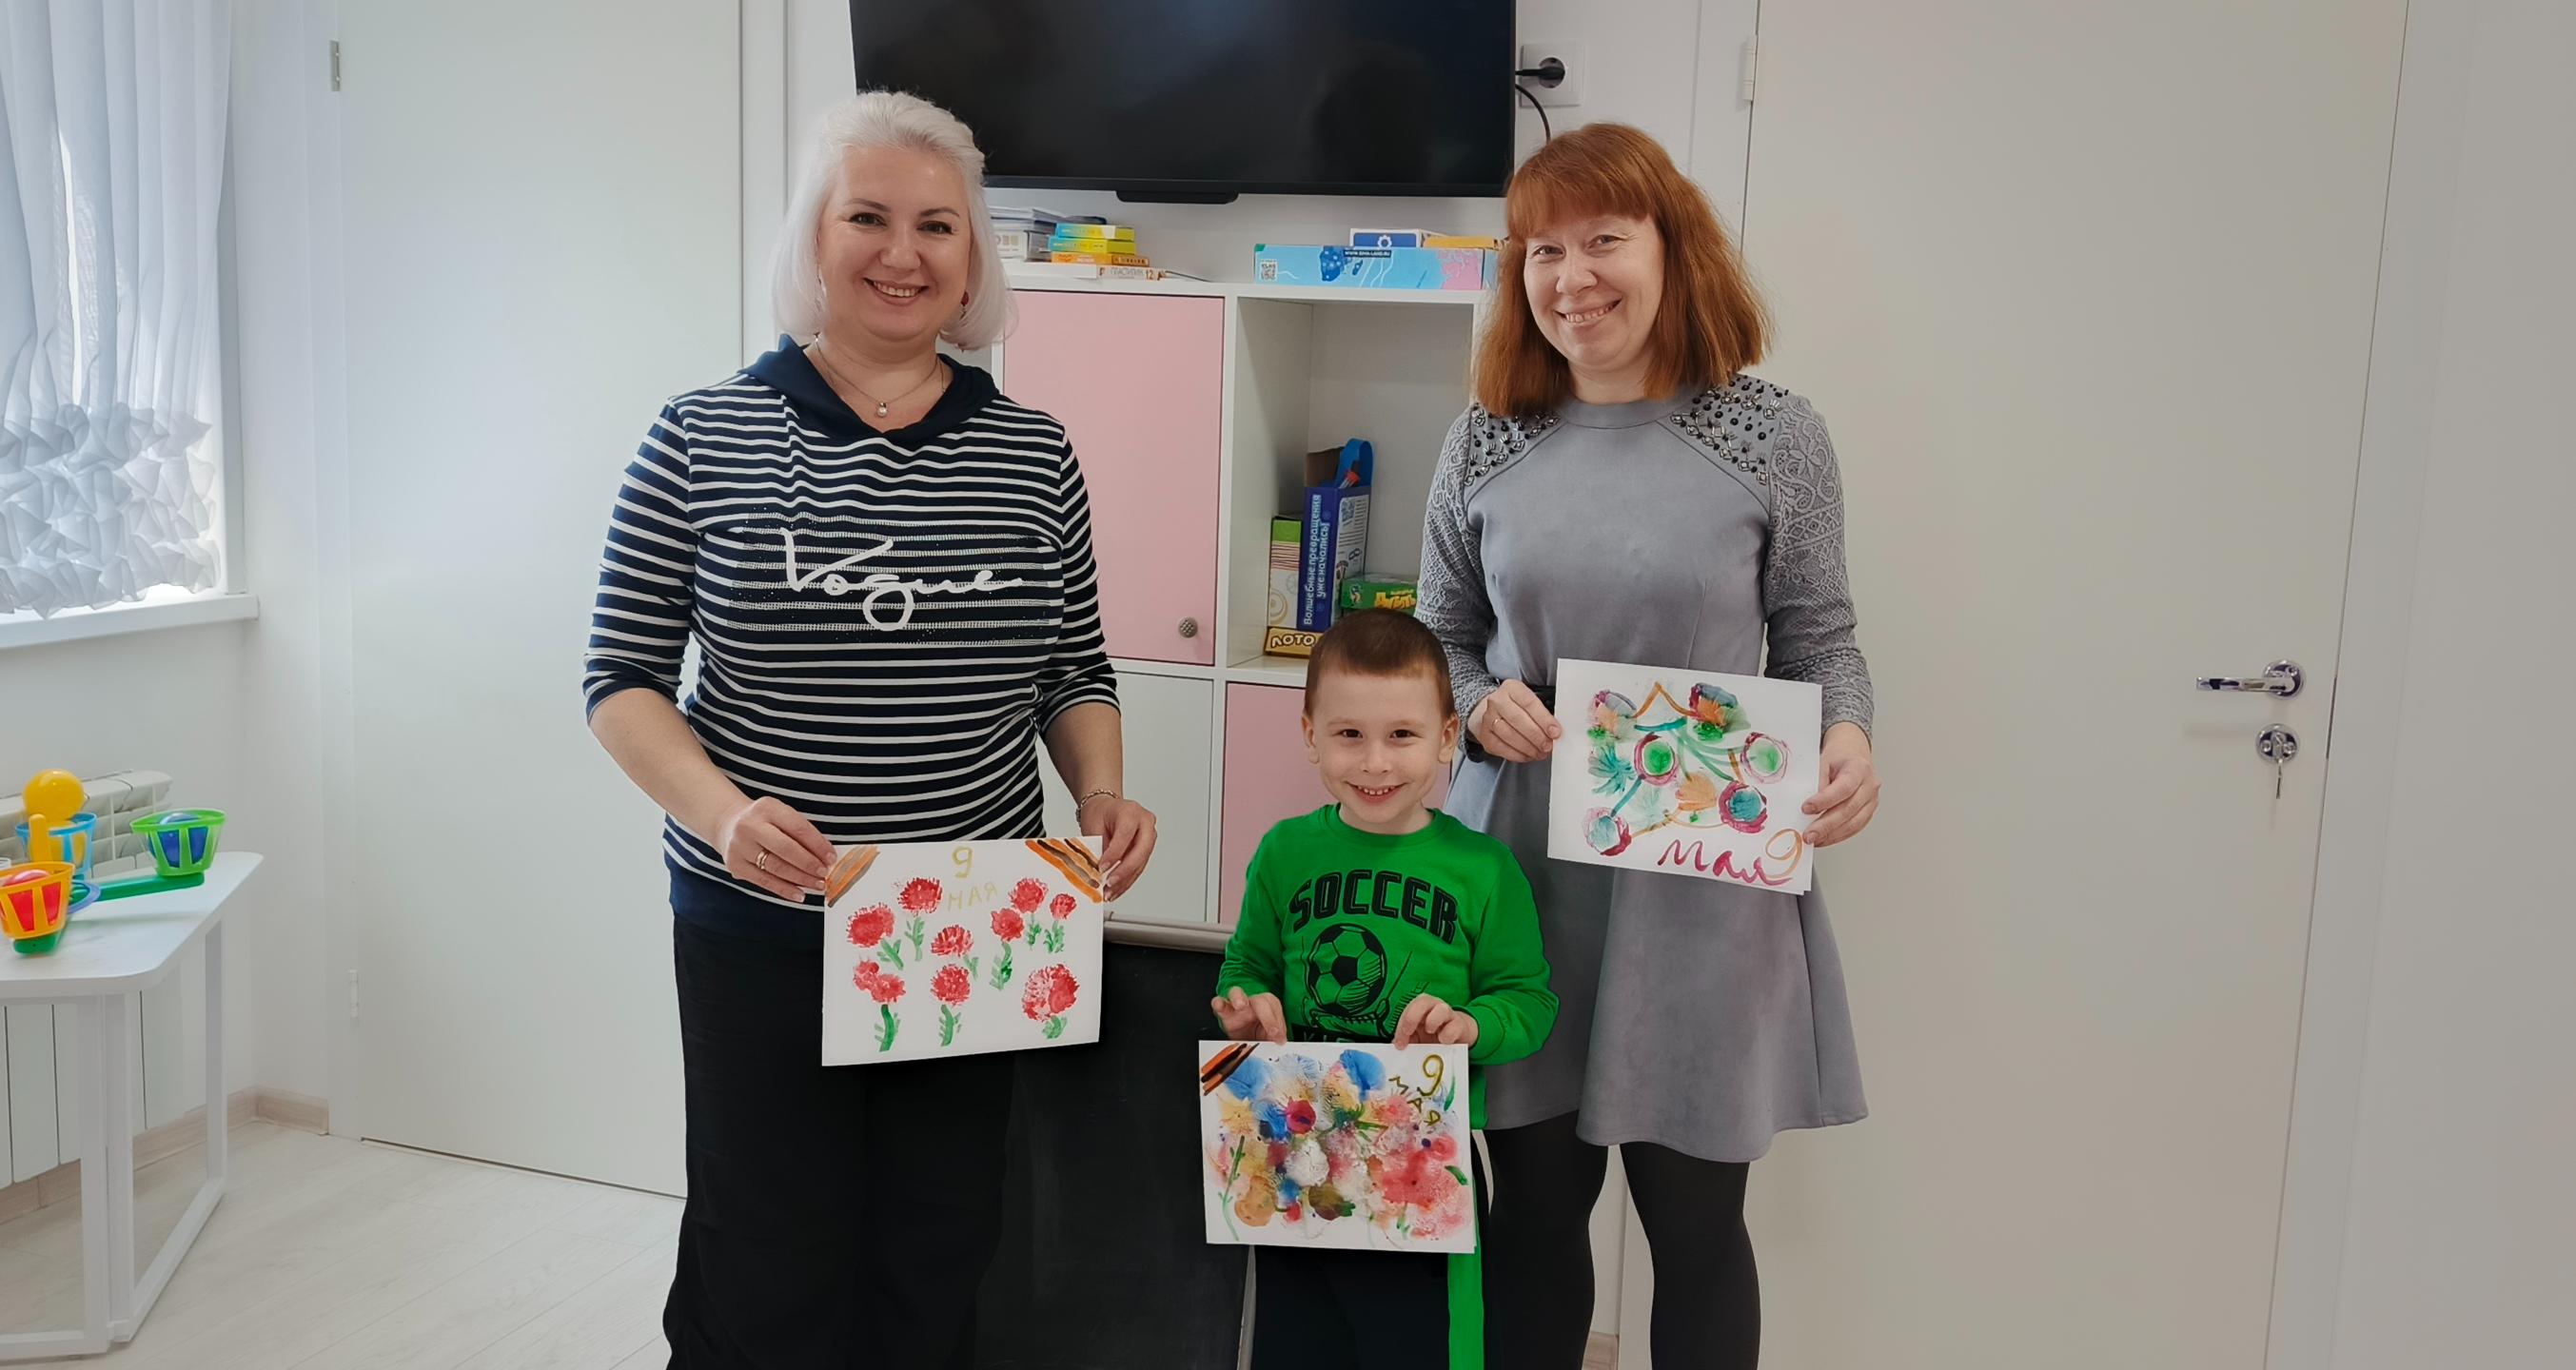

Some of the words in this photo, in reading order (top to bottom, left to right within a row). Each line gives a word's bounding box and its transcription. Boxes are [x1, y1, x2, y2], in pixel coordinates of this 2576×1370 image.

[1307, 494, 1322, 565] превращения
[780, 527, 1022, 632] Vogue
[1303, 566, 1316, 625] Волшебные
[1316, 577, 1327, 598] уже
[1271, 634, 1315, 648] ЛОТО
[952, 846, 973, 878] 9
[1766, 829, 1802, 878] 9
[1288, 869, 1458, 945] SOCCER
[1417, 1054, 1444, 1096] 9
